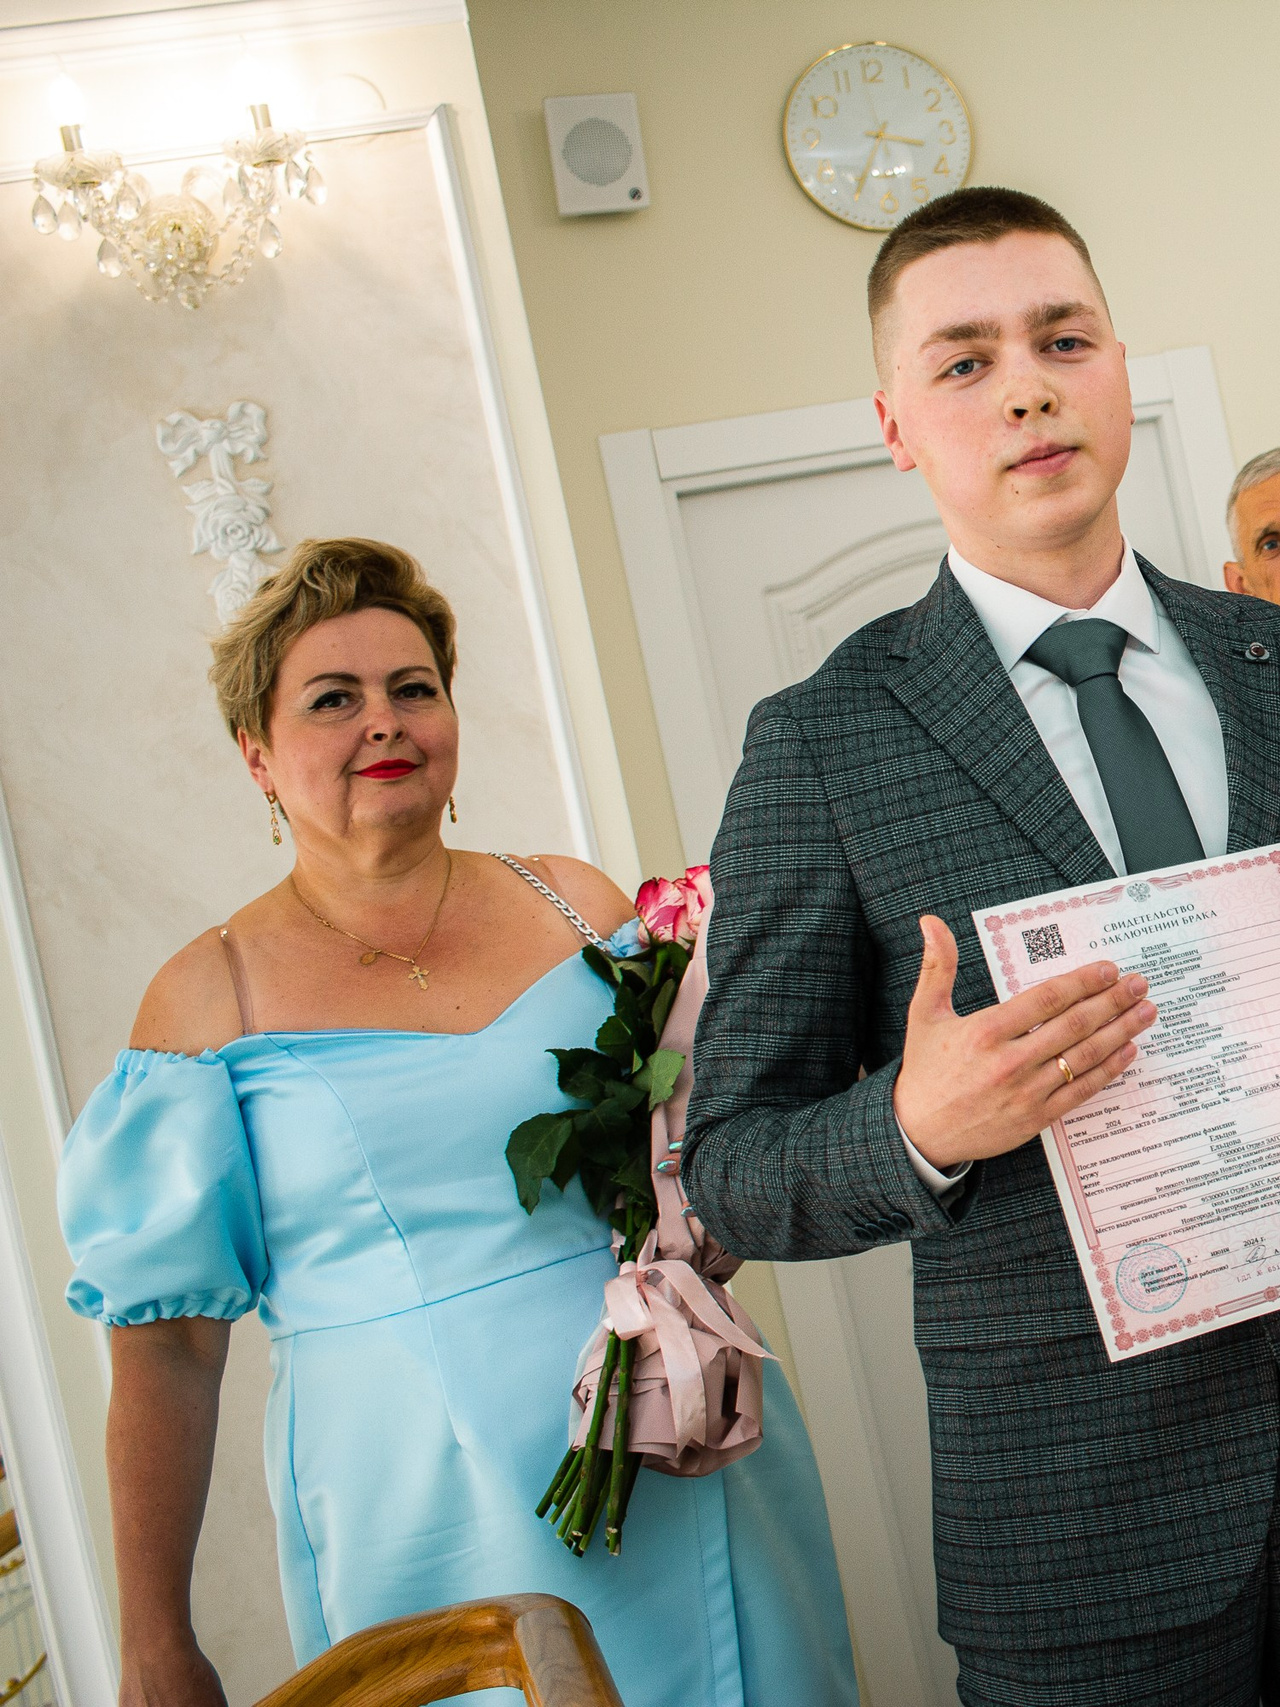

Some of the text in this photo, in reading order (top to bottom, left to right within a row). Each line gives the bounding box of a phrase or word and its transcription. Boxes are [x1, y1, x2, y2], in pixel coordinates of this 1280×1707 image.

[833, 70, 850, 93] 11
[860, 58, 884, 83] 12
[902, 65, 910, 90] 1
[810, 95, 838, 119] 10
[924, 88, 942, 113] 2
[802, 128, 821, 150] 9
[938, 119, 957, 145] 3
[817, 160, 835, 184] 8
[933, 154, 951, 177] 4
[879, 190, 899, 214] 6
[911, 178, 930, 204] 5
[1101, 919, 1178, 944] ЗАКЛЮЧЕНИИ
[1181, 910, 1216, 924] БРАКА
[1103, 904, 1194, 932] СВИДЕТЕЛЬСТВО
[1119, 949, 1198, 972] Александр Денисович
[1141, 948, 1171, 959] (фамилия)
[1148, 974, 1184, 988] ражданство)
[1163, 963, 1200, 976] Федерация
[1198, 971, 1226, 984] русский
[1176, 994, 1194, 1003] ЗАТО
[1194, 986, 1225, 998] Озерный
[1188, 975, 1240, 992] (национальность)
[1159, 1011, 1190, 1022] Михеева
[1162, 1017, 1192, 1028] (фамилия)
[1171, 1022, 1208, 1034] Сергеевна
[1145, 1033, 1221, 1056] Российская Федерация
[1156, 1036, 1181, 1046] отчество
[1166, 1043, 1206, 1057] (гражданство)
[1211, 1043, 1262, 1060] (национальность)
[1221, 1040, 1247, 1051] русская
[1121, 1068, 1136, 1078] 2001
[1138, 1071, 1185, 1087] Новгородская
[1186, 1064, 1215, 1074] область,
[1221, 1053, 1247, 1064] Валдай
[1169, 1068, 1220, 1086] (место рождения)
[1184, 1081, 1204, 1090] июня
[1205, 1075, 1220, 1084] 2024
[1064, 1104, 1120, 1125] заключили брак
[1105, 1119, 1121, 1128] 2024
[1141, 1110, 1156, 1118] года
[1178, 1098, 1197, 1107] июня
[1217, 1085, 1242, 1095] месяца
[1070, 1132, 1108, 1147] составлена
[1109, 1125, 1133, 1136] запись
[1134, 1120, 1150, 1128] акта
[1157, 1105, 1200, 1122] заключении
[1200, 1099, 1221, 1109] брака
[1076, 1121, 1235, 1171] После заключения брака присвоены фамилии:
[1079, 1130, 1236, 1180] мужу Ельцов
[1082, 1138, 1241, 1189] жене Ельцова
[1084, 1188, 1104, 1197] Место
[1105, 1171, 1158, 1191] государственной
[1159, 1160, 1200, 1176] регистрации
[1217, 1146, 1245, 1157] 95300004
[1245, 1140, 1265, 1149] Отдел
[1265, 1134, 1280, 1144] ЗАГС
[1155, 1180, 1184, 1192] Великого
[1185, 1170, 1219, 1183] Новгорода
[1219, 1156, 1263, 1173] Новгородской
[1120, 1196, 1157, 1210] произведена
[1158, 1181, 1205, 1198] государственная
[1206, 1170, 1242, 1184] регистрация
[1230, 1186, 1272, 1201] наименование
[1095, 1225, 1115, 1234] Место
[1115, 1217, 1140, 1228] выдачи
[1141, 1203, 1186, 1220] свидетельства
[1200, 1190, 1229, 1202] 95300004
[1229, 1185, 1249, 1194] Отдел
[1249, 1178, 1264, 1188] ЗАГС
[1181, 1211, 1214, 1224] Новгорода
[1215, 1197, 1259, 1214] Новгородской
[1125, 1232, 1167, 1248] свидетельство
[1173, 1215, 1221, 1234] государственной
[1222, 1205, 1259, 1220] регистрации
[1210, 1247, 1229, 1256] июня
[1243, 1237, 1258, 1246] 2024
[1198, 1264, 1228, 1278] работник)
